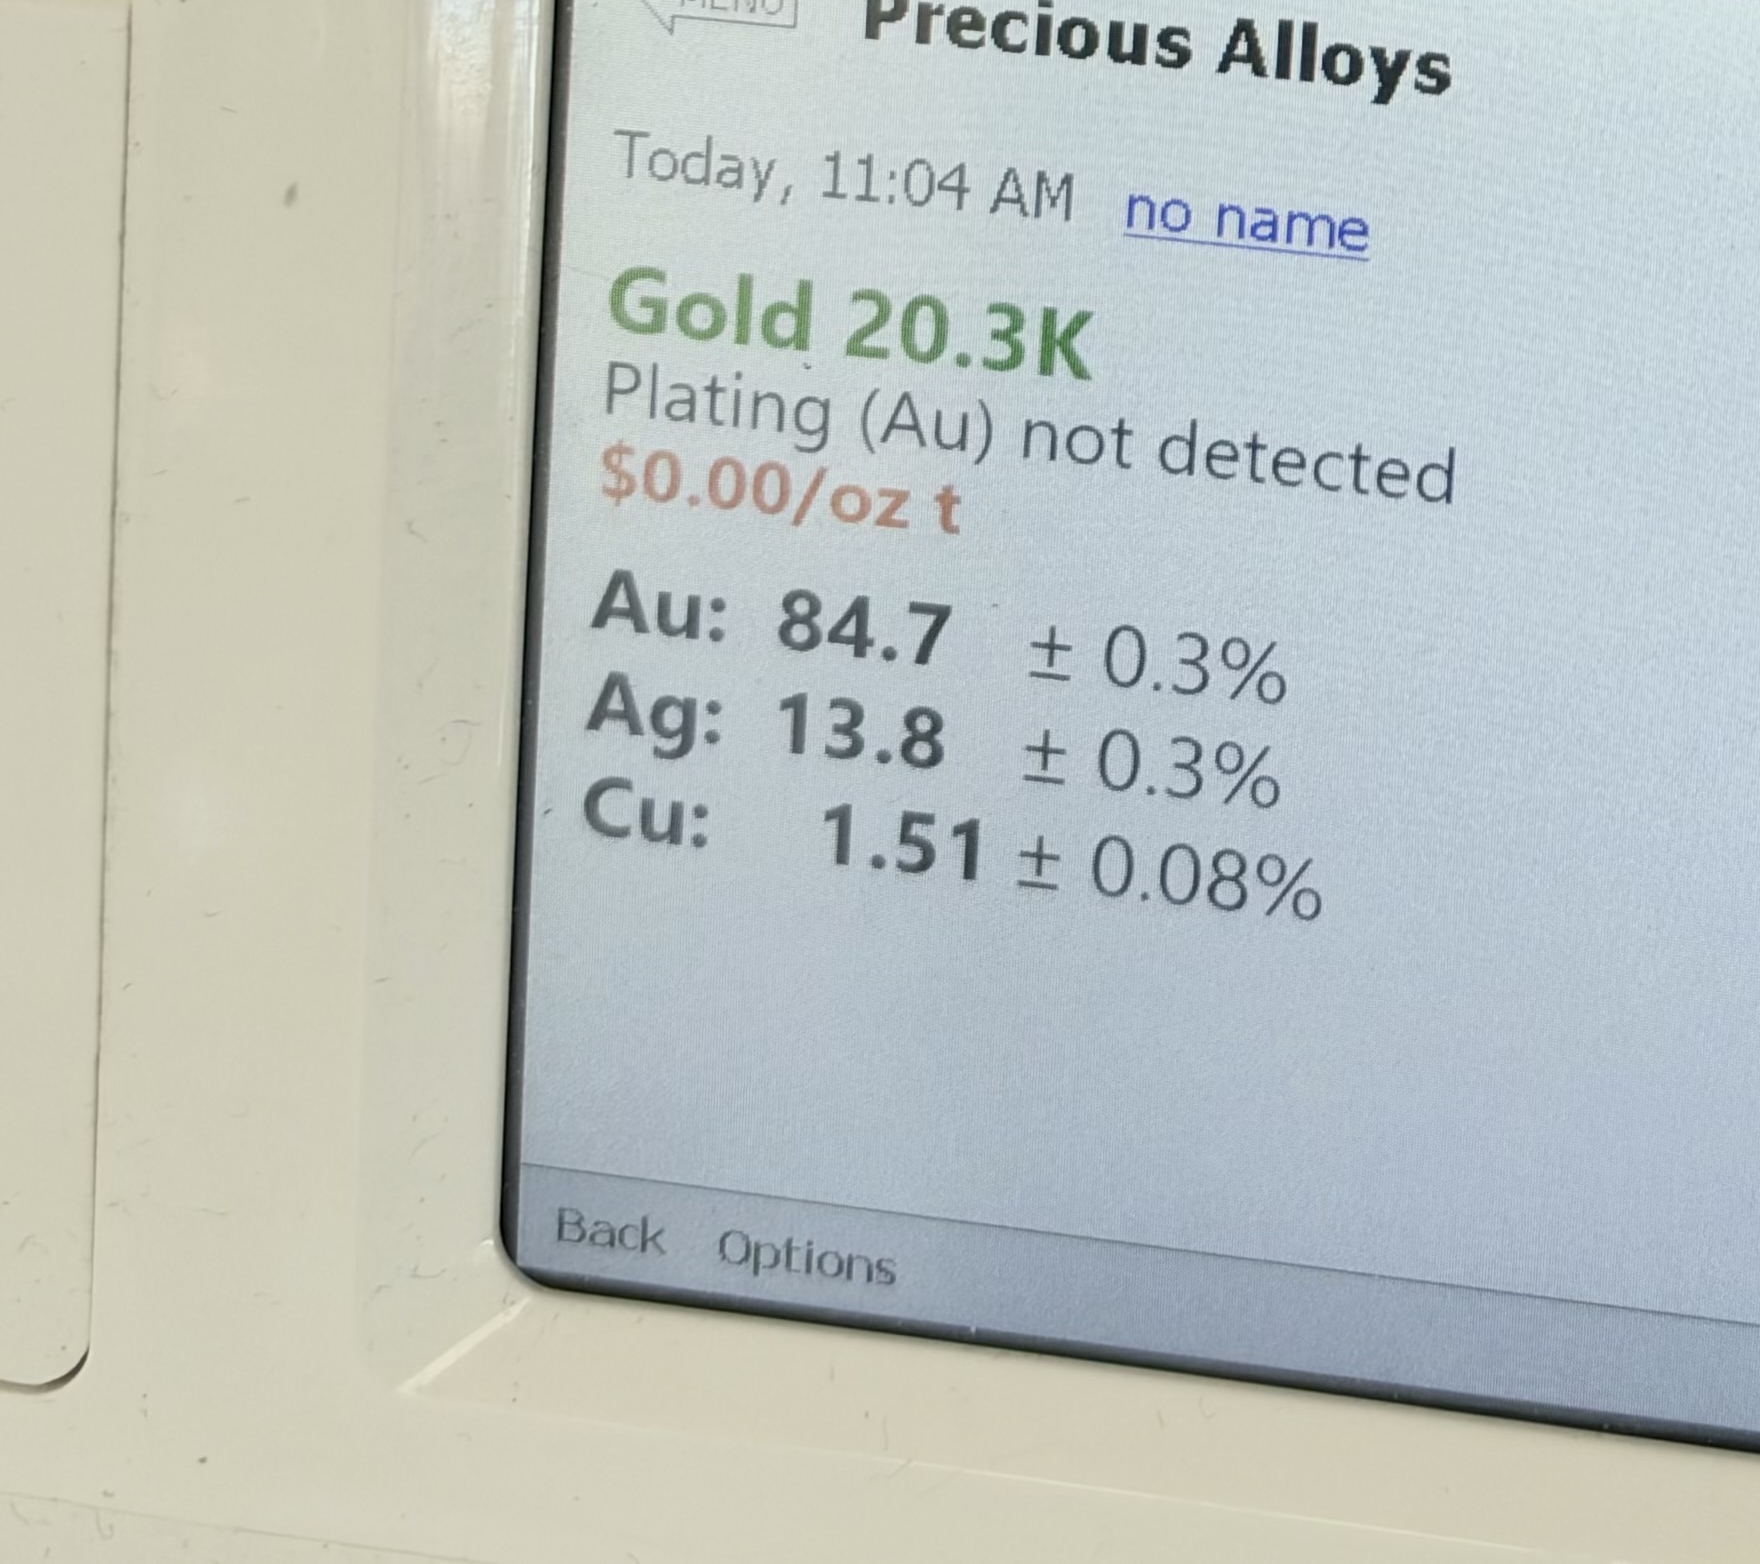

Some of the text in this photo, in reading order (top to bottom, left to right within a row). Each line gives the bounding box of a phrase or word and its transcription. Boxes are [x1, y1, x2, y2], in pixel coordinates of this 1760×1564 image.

[1216, 15, 1454, 105] Alloys
[612, 128, 1076, 223] Today, 11:04 AM
[1124, 185, 1372, 257] no name
[606, 263, 1096, 383] Gold 20.3K
[600, 439, 964, 535] $0.00/oz t
[603, 361, 1458, 505] Plating (Au) not detected
[590, 567, 728, 645] Au:
[776, 587, 954, 669] 84.7
[1102, 623, 1290, 707] 0.3%
[584, 671, 722, 761] Ag:
[778, 691, 948, 771] 13.8
[1096, 729, 1283, 811] 0.3%
[581, 776, 711, 851] Cu:
[823, 801, 985, 883] 1.51
[1089, 833, 1325, 923] 0.08%
[556, 1206, 899, 1287] Back Options
